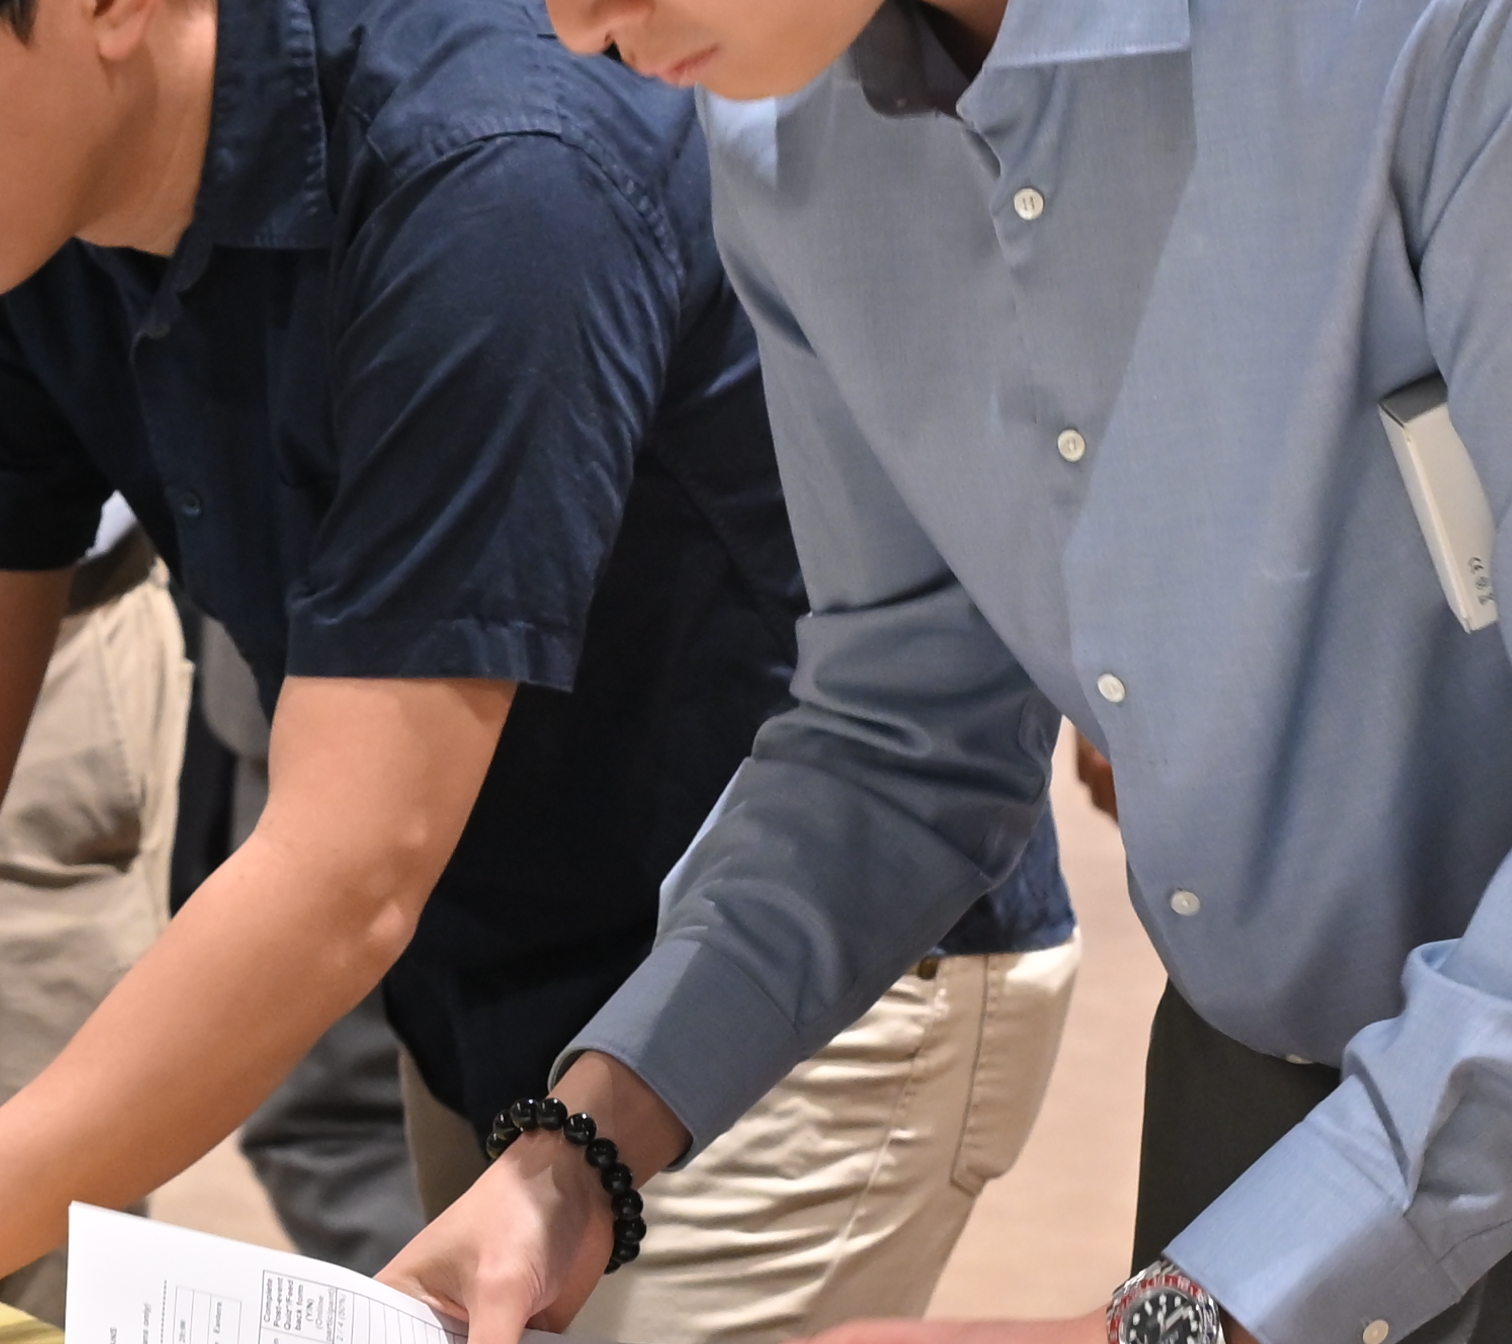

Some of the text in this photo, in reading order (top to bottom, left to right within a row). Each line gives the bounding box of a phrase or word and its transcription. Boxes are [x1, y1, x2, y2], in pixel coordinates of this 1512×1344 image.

[263, 1278, 274, 1323] Complete
[273, 1277, 284, 1328] Post-event
[294, 1284, 304, 1331] back form
